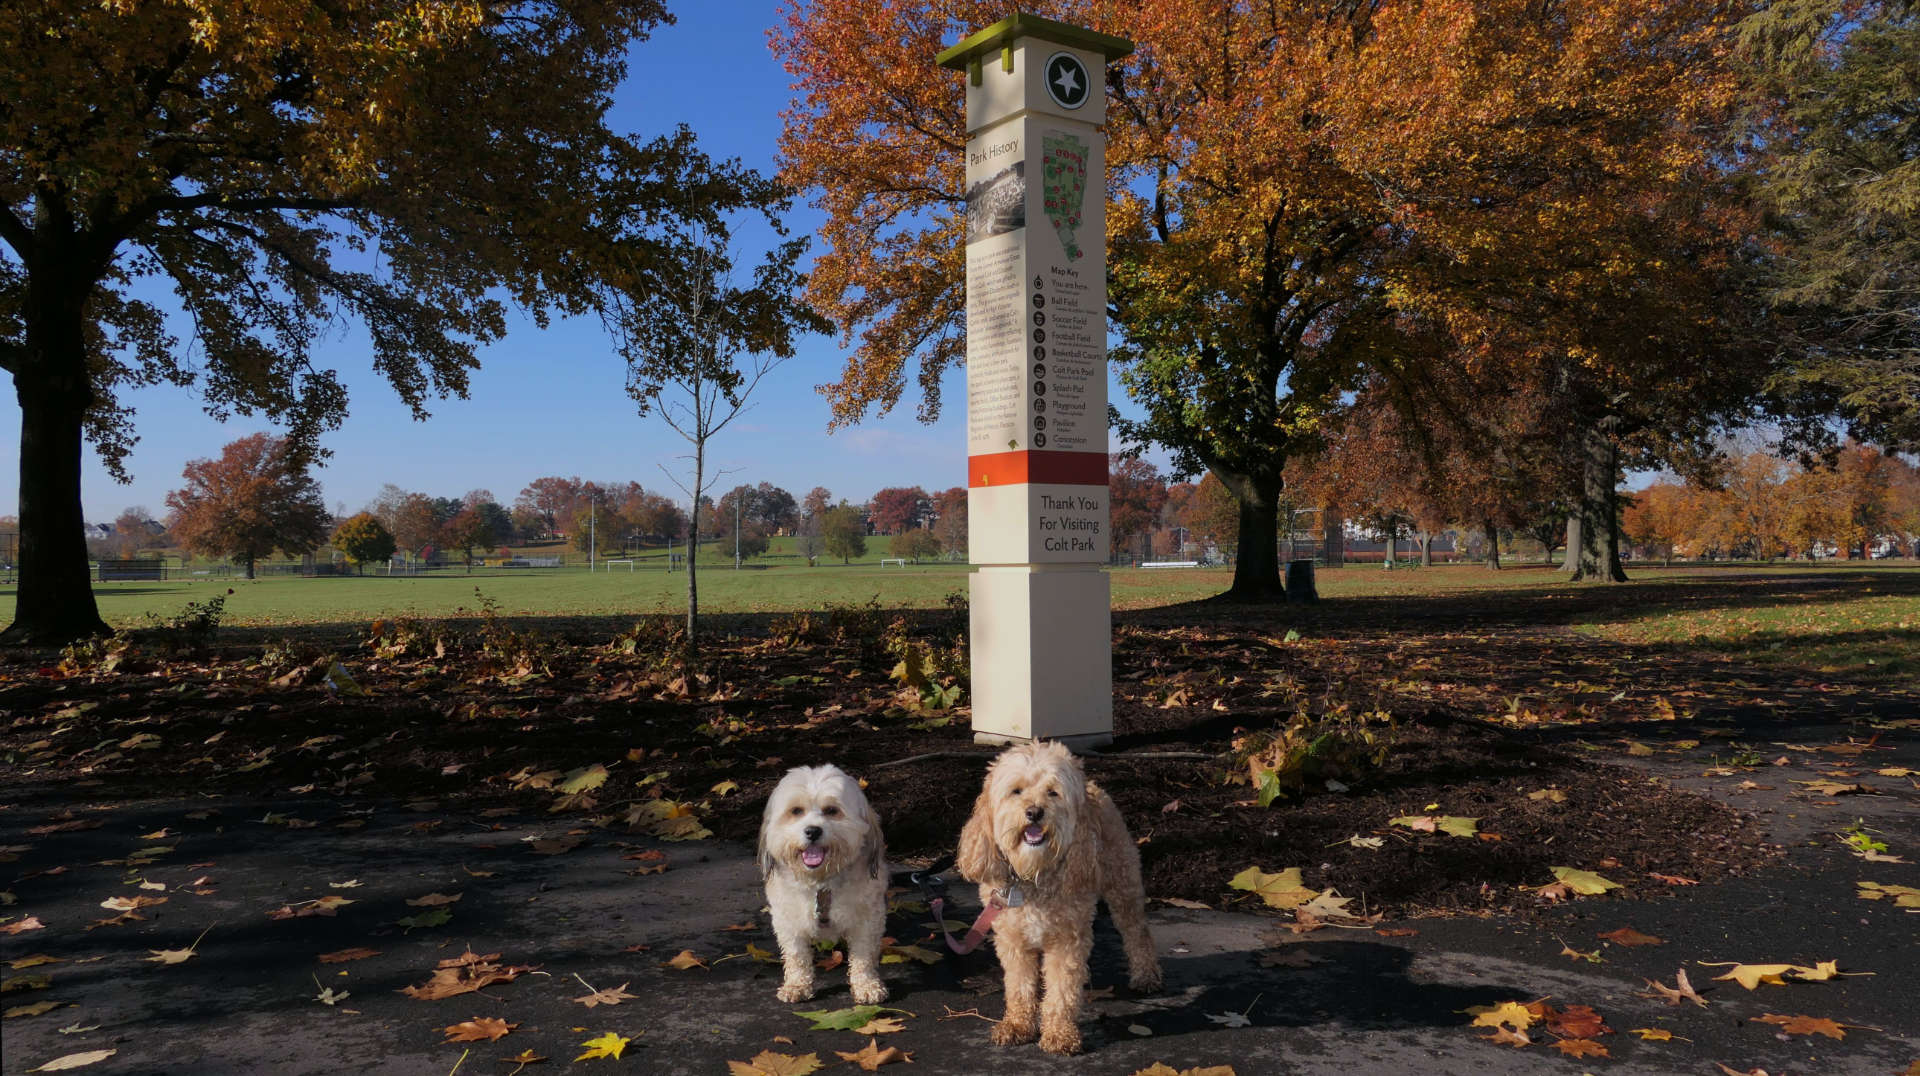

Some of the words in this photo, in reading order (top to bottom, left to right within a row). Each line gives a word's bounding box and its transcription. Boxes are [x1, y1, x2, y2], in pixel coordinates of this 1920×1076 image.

[970, 147, 987, 167] Park
[989, 136, 1019, 159] History
[1051, 266, 1066, 276] Map
[1067, 268, 1080, 278] Key
[1051, 297, 1063, 305] Ball
[1064, 298, 1078, 306] Field
[1073, 316, 1087, 325] Field
[1052, 331, 1076, 341] Football
[1077, 333, 1091, 342] Field
[1052, 365, 1066, 374] Colt
[1066, 366, 1080, 375] Park
[1081, 368, 1094, 376] Pool
[1052, 383, 1072, 393] Splash
[1073, 385, 1084, 393] Pad
[1052, 400, 1086, 411] Playground
[1041, 495, 1076, 510] Thank
[1078, 496, 1098, 510] You
[1040, 516, 1057, 530] For
[1060, 516, 1099, 534] Visiting
[1044, 537, 1069, 551] Colt
[1071, 538, 1095, 551] Park
